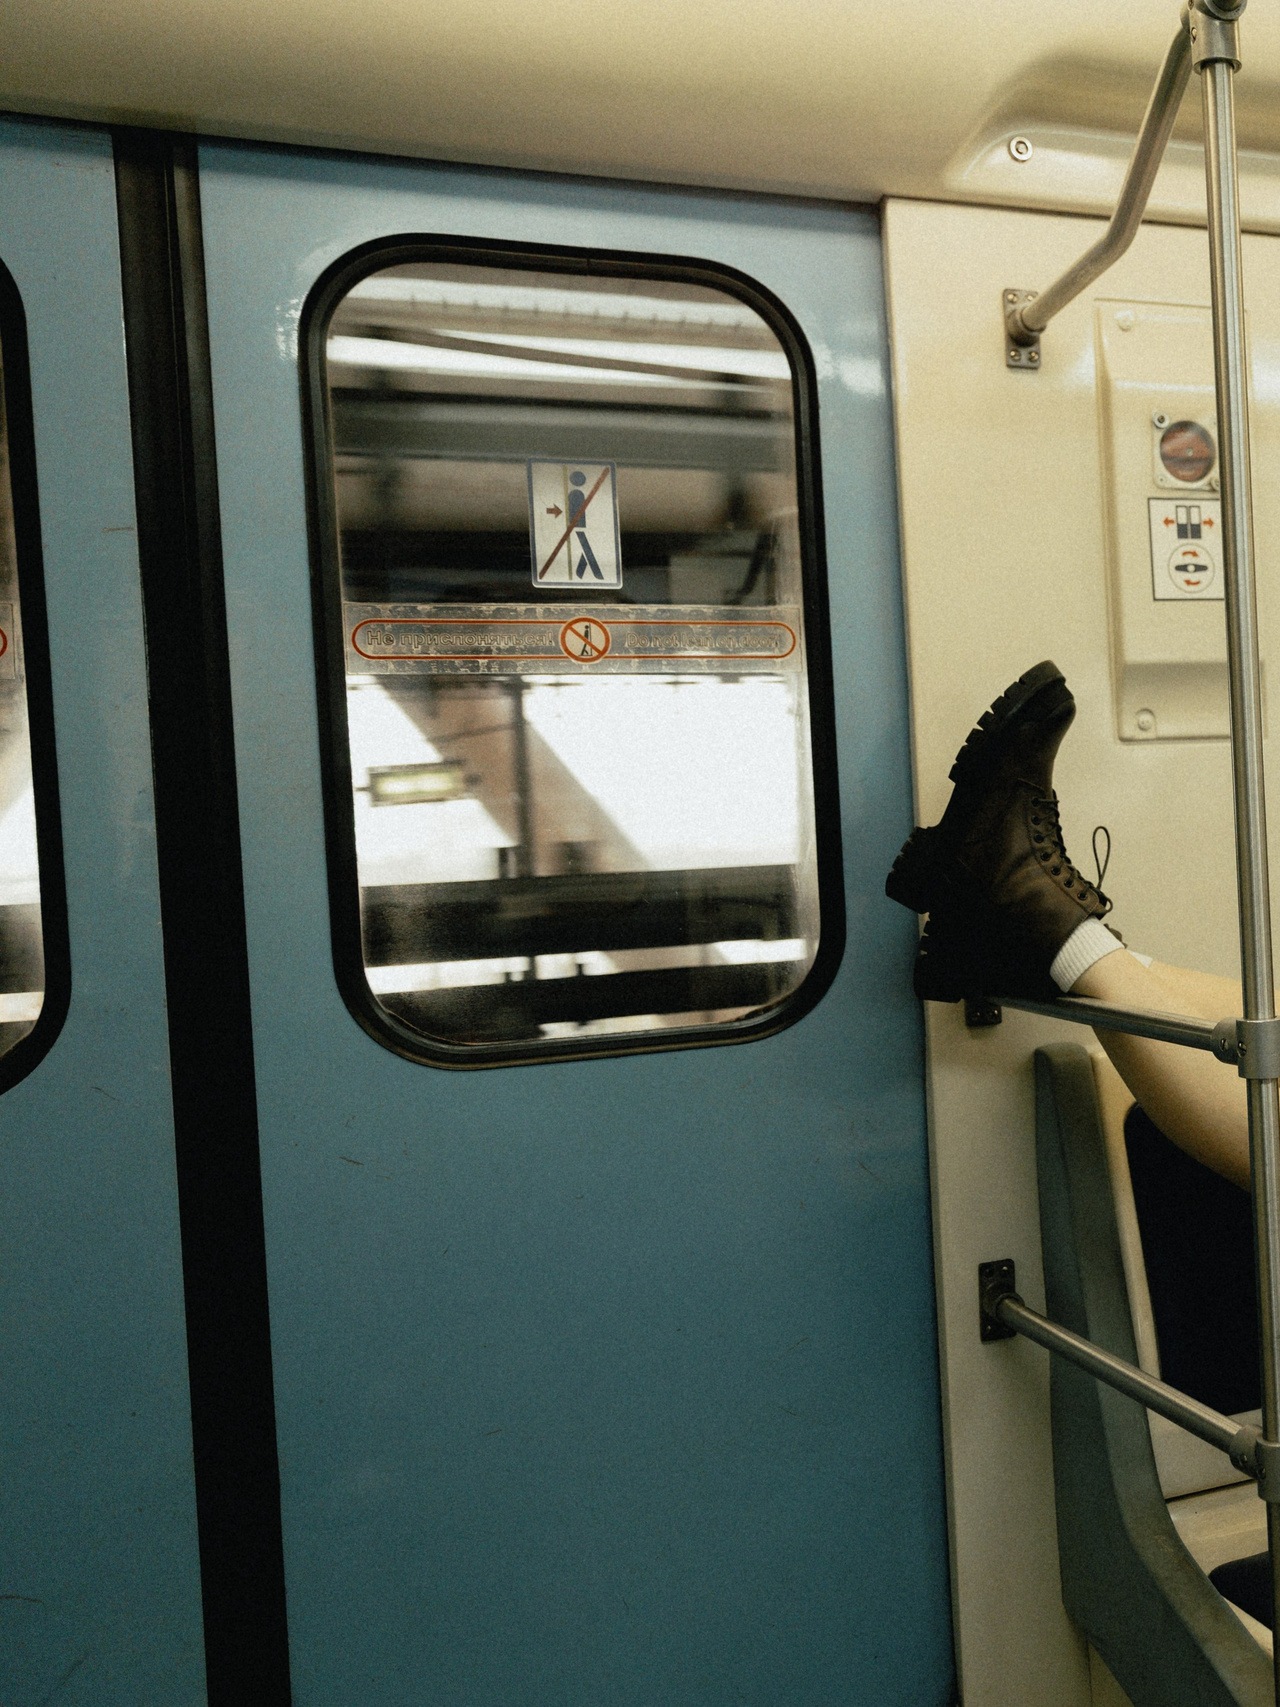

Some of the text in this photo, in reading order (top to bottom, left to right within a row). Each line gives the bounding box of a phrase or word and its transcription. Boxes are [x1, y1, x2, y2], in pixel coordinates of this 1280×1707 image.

[366, 630, 554, 649] Не прислоняться!
[626, 632, 649, 648] Do
[652, 632, 679, 648] not
[681, 632, 714, 648] lean
[716, 635, 737, 648] on
